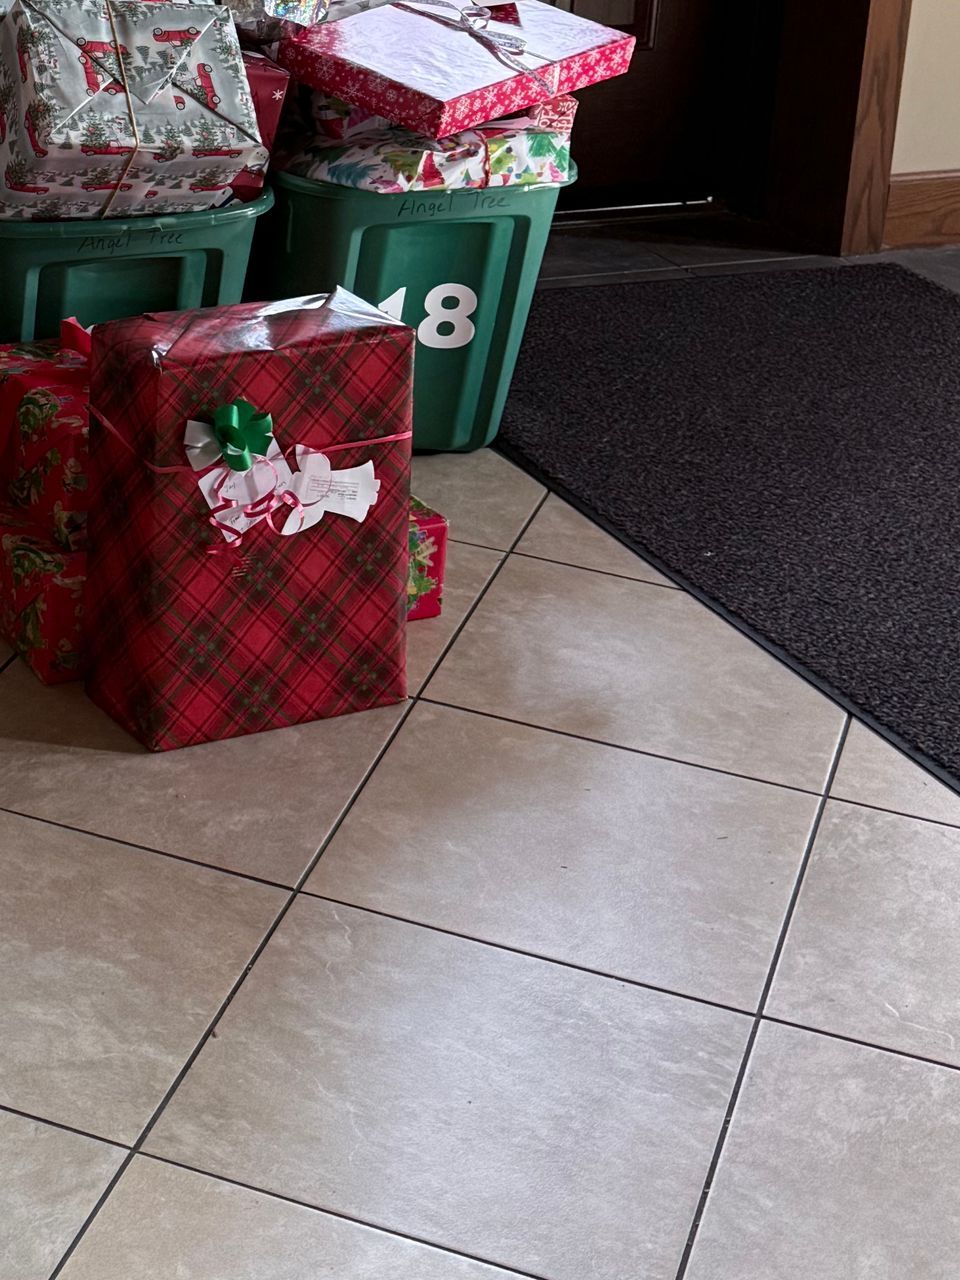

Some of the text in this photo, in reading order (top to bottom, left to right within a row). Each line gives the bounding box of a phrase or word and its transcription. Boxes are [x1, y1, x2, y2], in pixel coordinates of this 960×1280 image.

[398, 192, 511, 217] Angel Tree
[77, 229, 184, 254] Angel Tree
